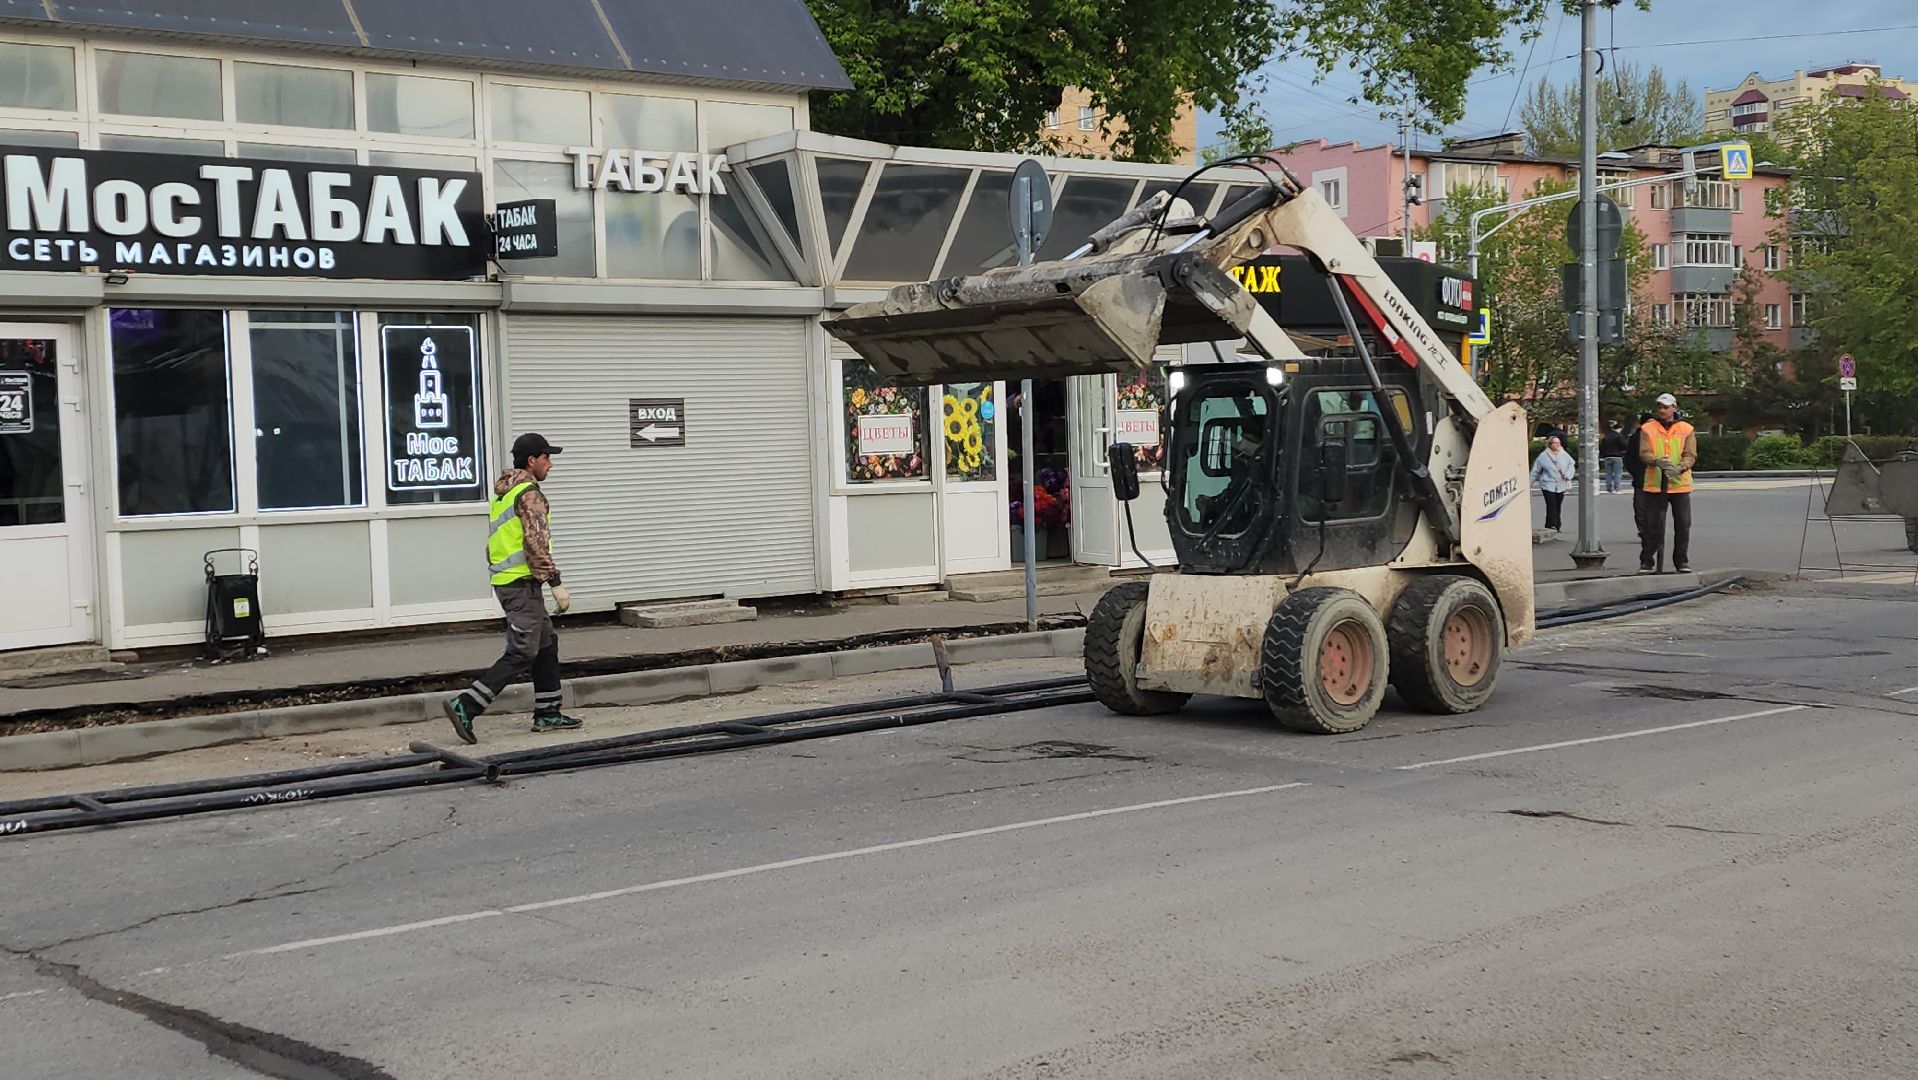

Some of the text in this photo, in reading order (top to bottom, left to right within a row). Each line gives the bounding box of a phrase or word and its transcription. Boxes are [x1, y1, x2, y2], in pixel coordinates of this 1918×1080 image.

[564, 146, 728, 195] ТАБАК
[498, 205, 537, 229] ТАБАК
[8, 238, 336, 269] СЕТЬ МАГАЗИНОВ
[499, 233, 537, 252] 24 ЧАСА
[1383, 290, 1429, 346] LONKING
[0, 395, 23, 411] 24
[638, 407, 676, 421] ВХОД
[406, 432, 459, 455] Мос
[863, 427, 909, 442] ЦВЕТЫ
[394, 456, 473, 482] ТАБАК
[1483, 476, 1518, 507] CDM312
